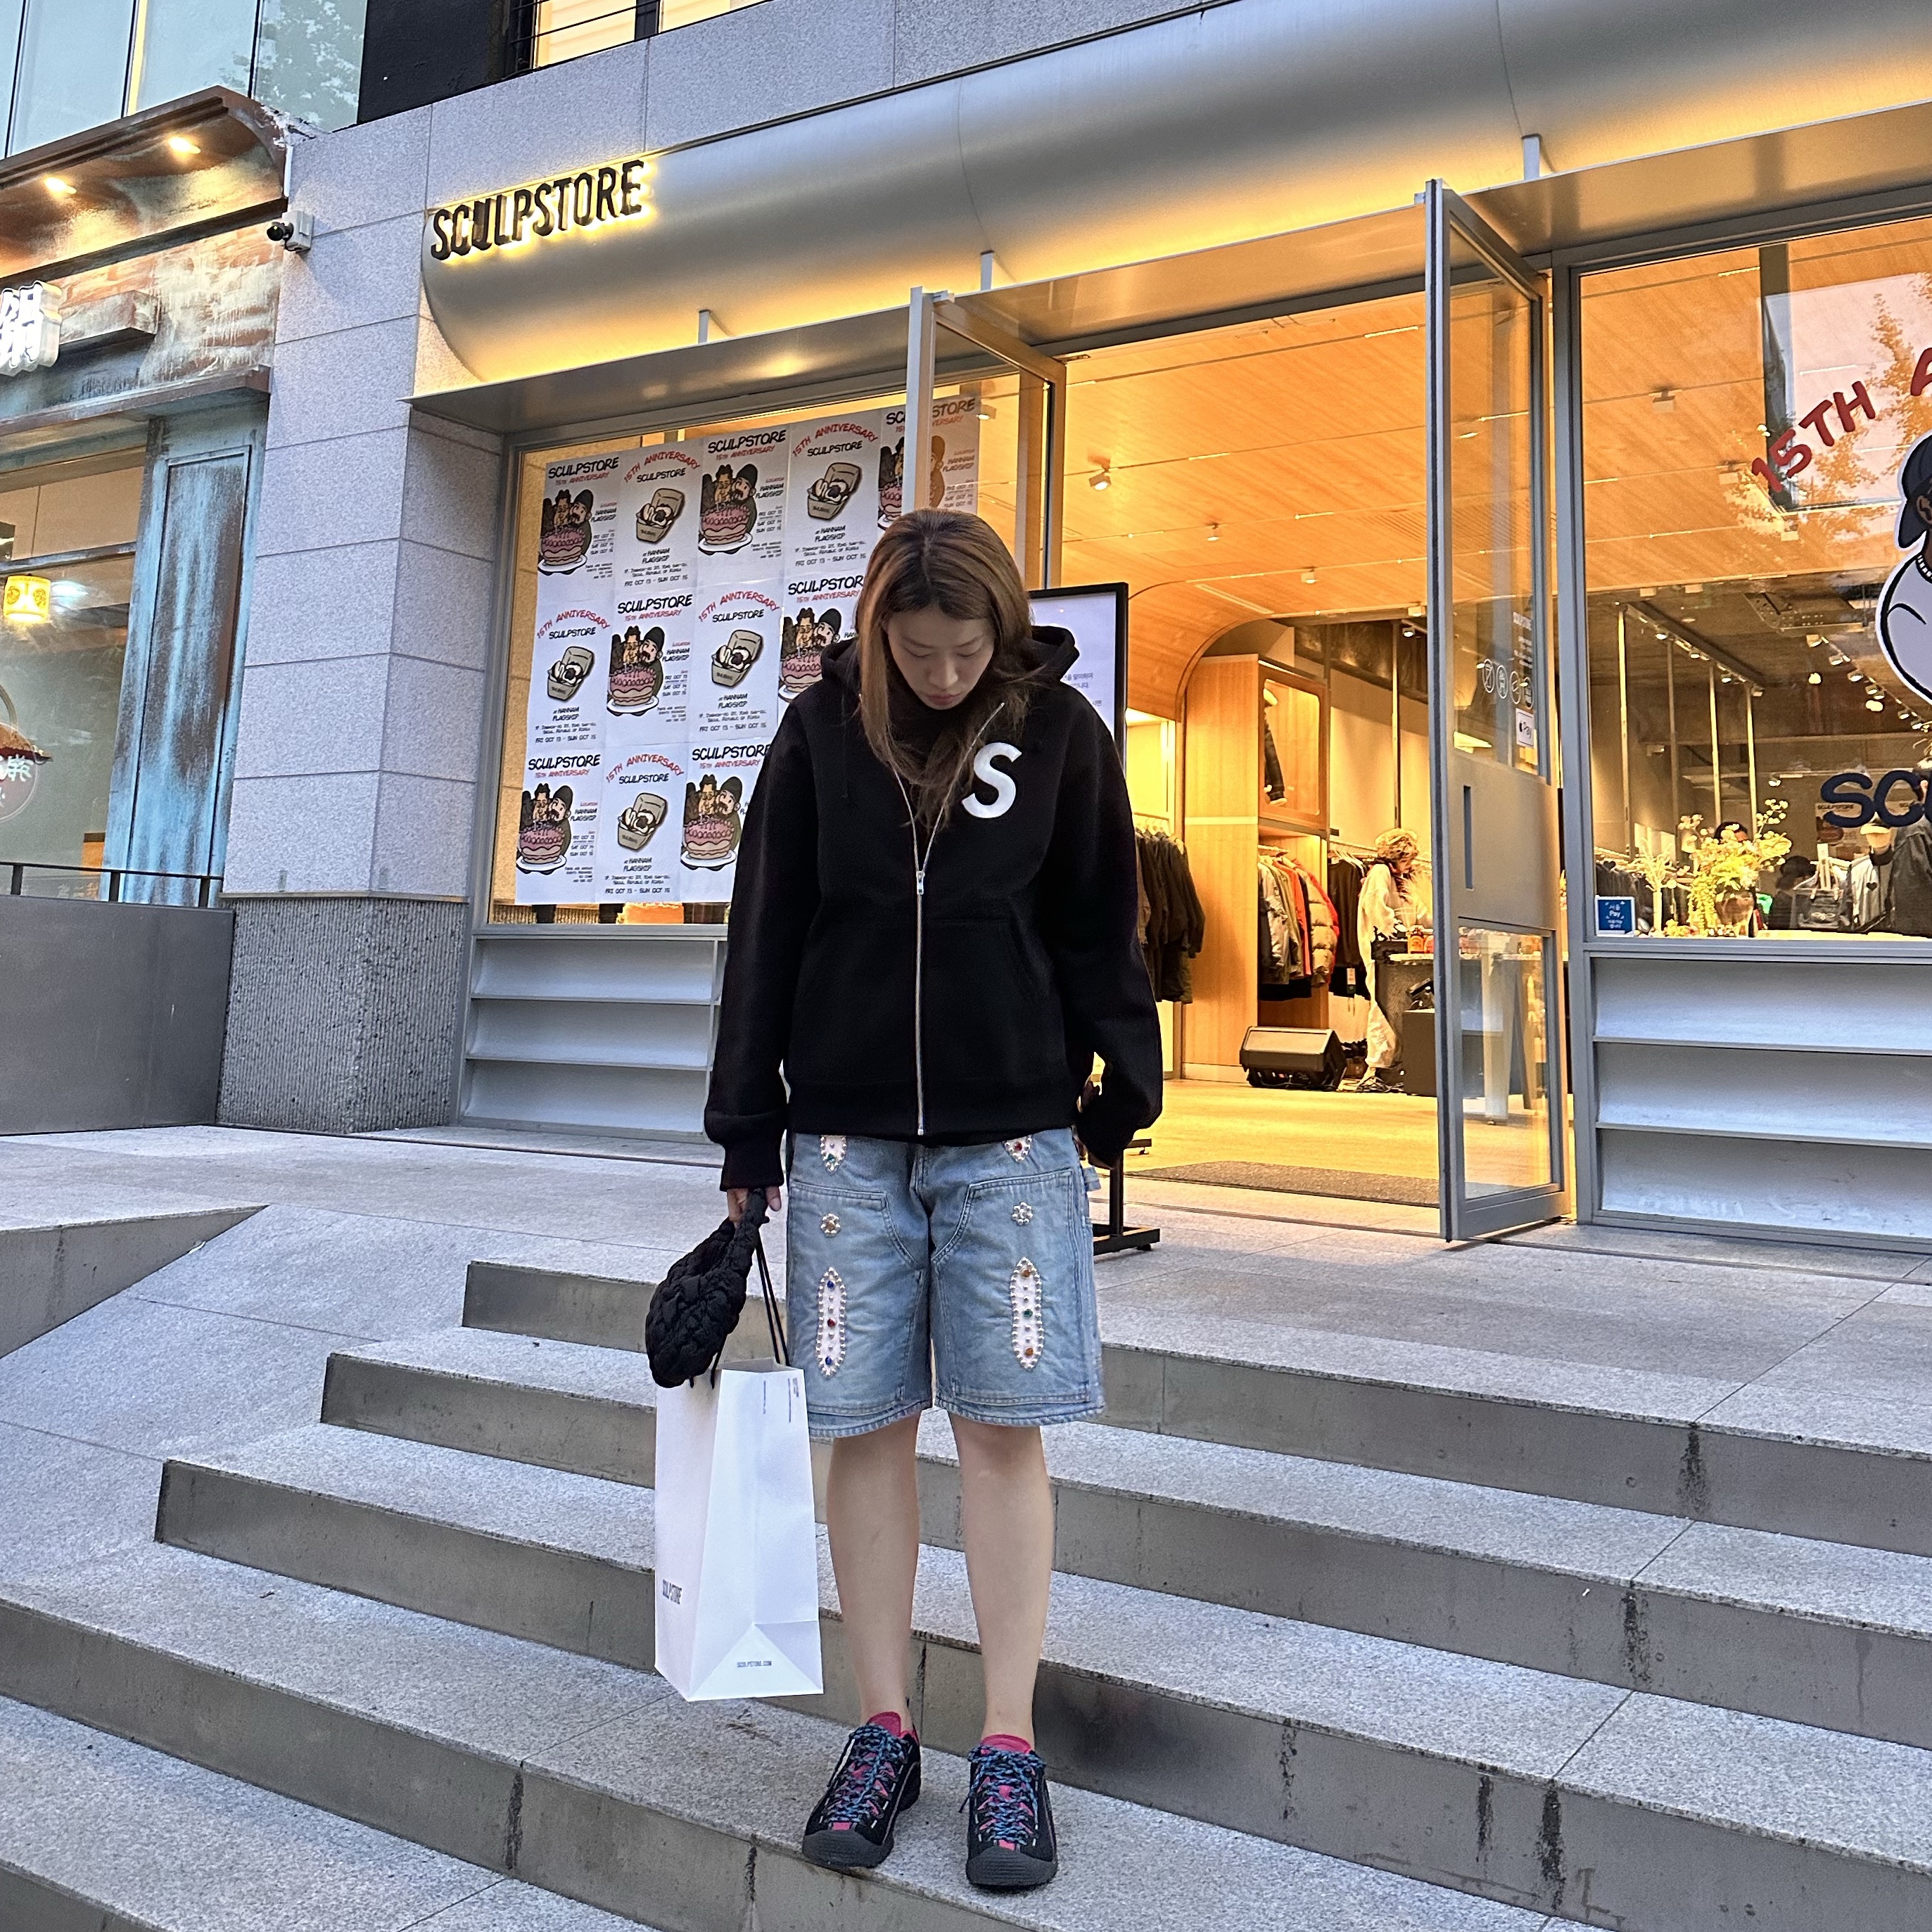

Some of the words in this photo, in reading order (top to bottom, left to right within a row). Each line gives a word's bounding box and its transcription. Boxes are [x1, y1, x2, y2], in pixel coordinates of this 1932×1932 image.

[431, 160, 644, 261] SCULPSTORE
[708, 429, 787, 454] SCULPSTORE
[792, 436, 811, 456] 15TH
[815, 423, 878, 443] ANNIVERSARY
[1752, 381, 1876, 492] 15TH
[730, 445, 775, 457] ANNIVERSARY
[807, 440, 863, 457] SCULPSTORE
[548, 457, 619, 478] SCULPSTORE
[624, 462, 640, 483] 15TH
[644, 450, 701, 470] ANNIVERSARY
[943, 462, 974, 472] FLAGSHIP
[569, 471, 610, 483] ANNIVERSARY
[636, 468, 687, 483] SCULPSTORE
[815, 533, 846, 542] FLAGSHIP
[642, 555, 670, 564] FLAGSHIP
[788, 575, 864, 595] SCULPSTOR
[617, 594, 693, 614] SCULPSTORE
[811, 590, 860, 602] ANNIVERSARY
[698, 602, 716, 622] 15TH
[720, 590, 780, 611] ANNIVERSARY
[638, 609, 682, 621] ANNIVERSARY
[712, 609, 765, 623] SCULPSTORE
[537, 621, 552, 639] 15TH
[556, 609, 611, 629] ANNIVERSARY
[549, 627, 597, 640] SCULPSTORE
[718, 701, 747, 709] FLAGSHIP
[528, 754, 601, 770] SCULPSTORE
[606, 763, 623, 783] 15TH
[626, 754, 685, 776] ANNIVERSARY
[715, 758, 761, 768] ANNIVERSARY
[548, 769, 590, 777] ANNIVERSARY
[618, 773, 670, 784] SCULPSTORE
[962, 742, 1022, 819] S
[1821, 770, 1932, 827] SC
